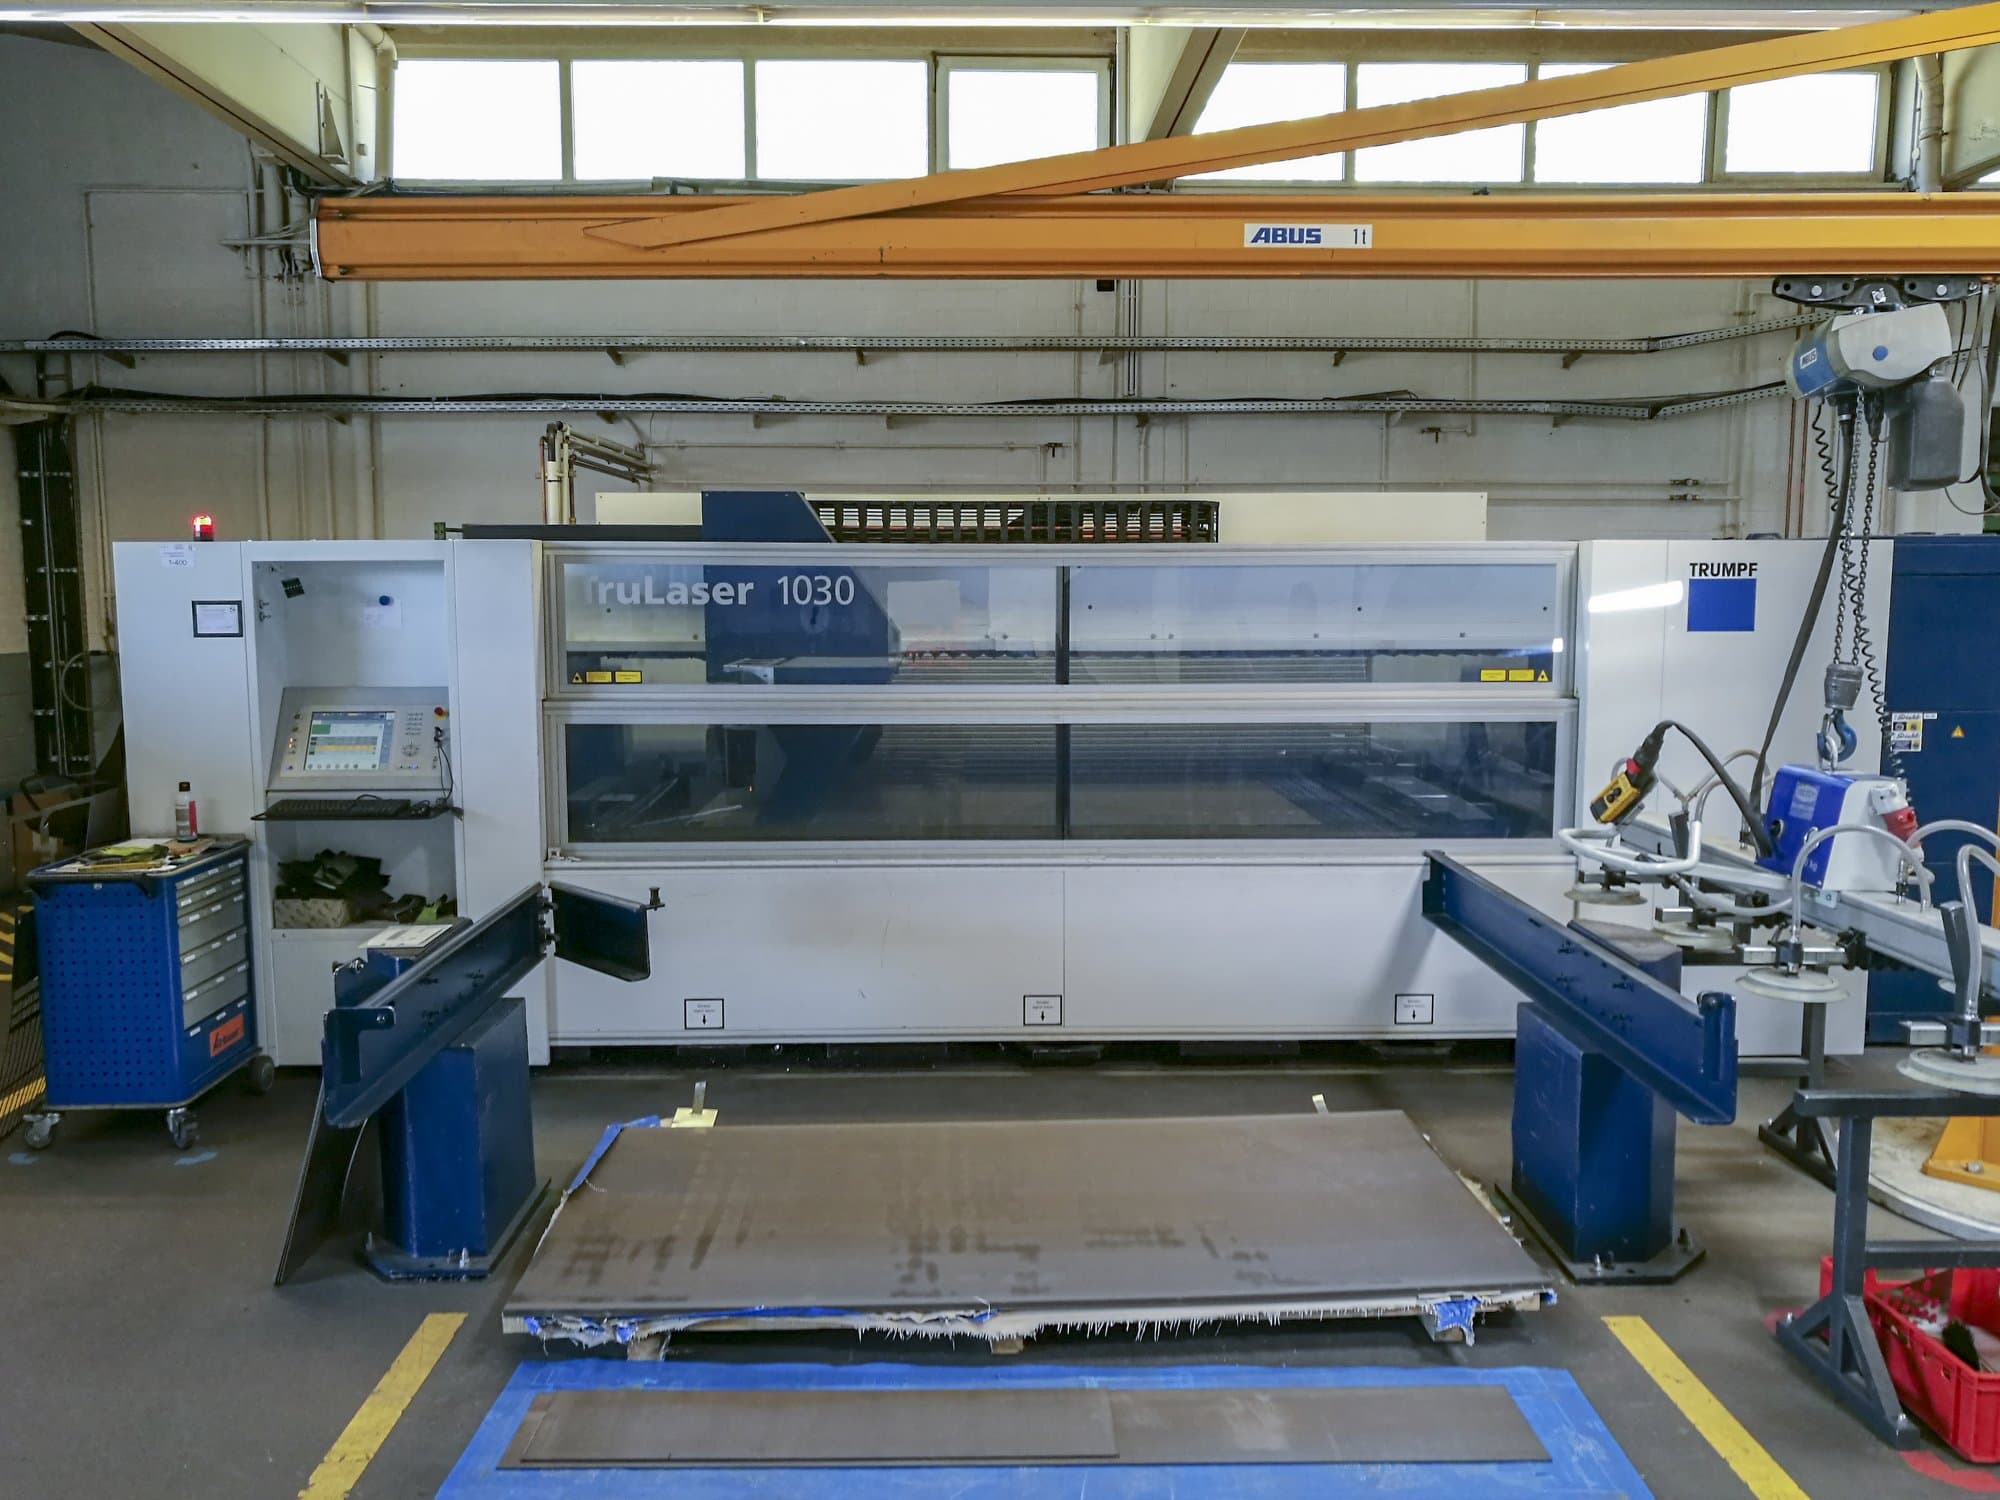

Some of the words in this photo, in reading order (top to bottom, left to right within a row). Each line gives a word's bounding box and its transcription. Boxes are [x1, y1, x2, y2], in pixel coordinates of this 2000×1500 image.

[1250, 227, 1322, 244] ABUS
[1689, 562, 1758, 577] TRUMPF
[777, 575, 855, 606] 1030
